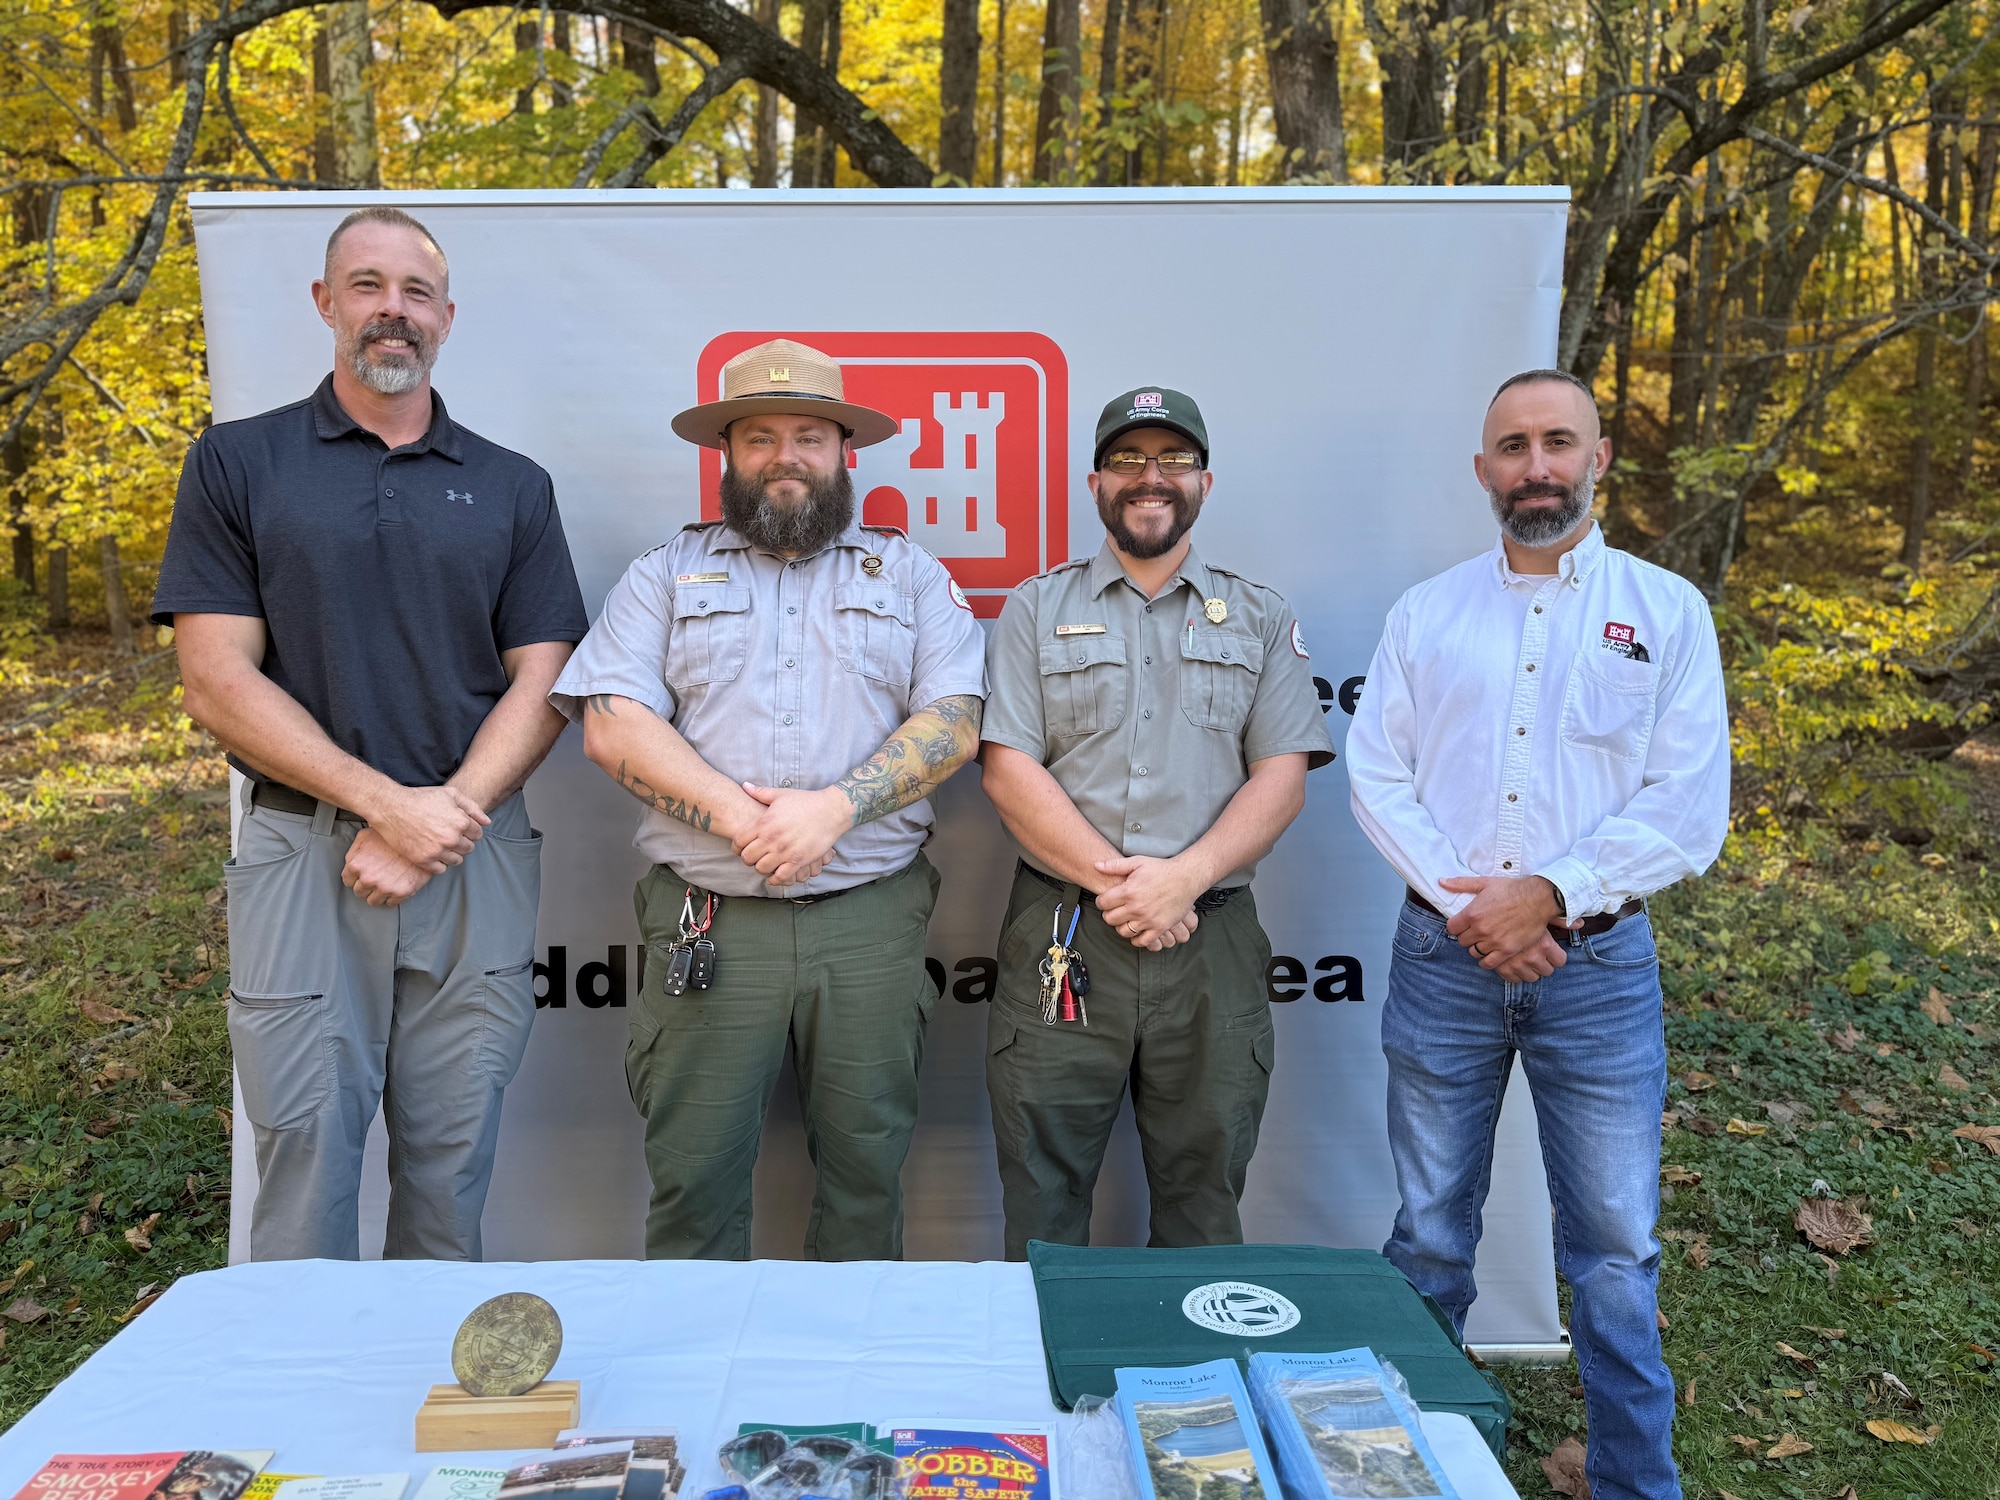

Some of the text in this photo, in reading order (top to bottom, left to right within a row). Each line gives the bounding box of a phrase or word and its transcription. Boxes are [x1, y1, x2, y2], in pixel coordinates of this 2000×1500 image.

[1127, 408, 1135, 416] US
[1151, 407, 1170, 415] Corps
[1136, 411, 1166, 419] Engineers
[1614, 641, 1630, 650] Army
[1246, 1286, 1275, 1300] Jackets
[1281, 1356, 1357, 1366] Monroe Lake
[1141, 1373, 1217, 1387] Monroe Lake
[48, 1459, 174, 1470] THE TRUE STORY OF
[896, 1454, 1037, 1483] BOBBER
[31, 1469, 165, 1489] SMOKEY
[952, 1477, 978, 1487] the
[39, 1489, 119, 1500] BEAR
[964, 1487, 1033, 1500] SAFETY
